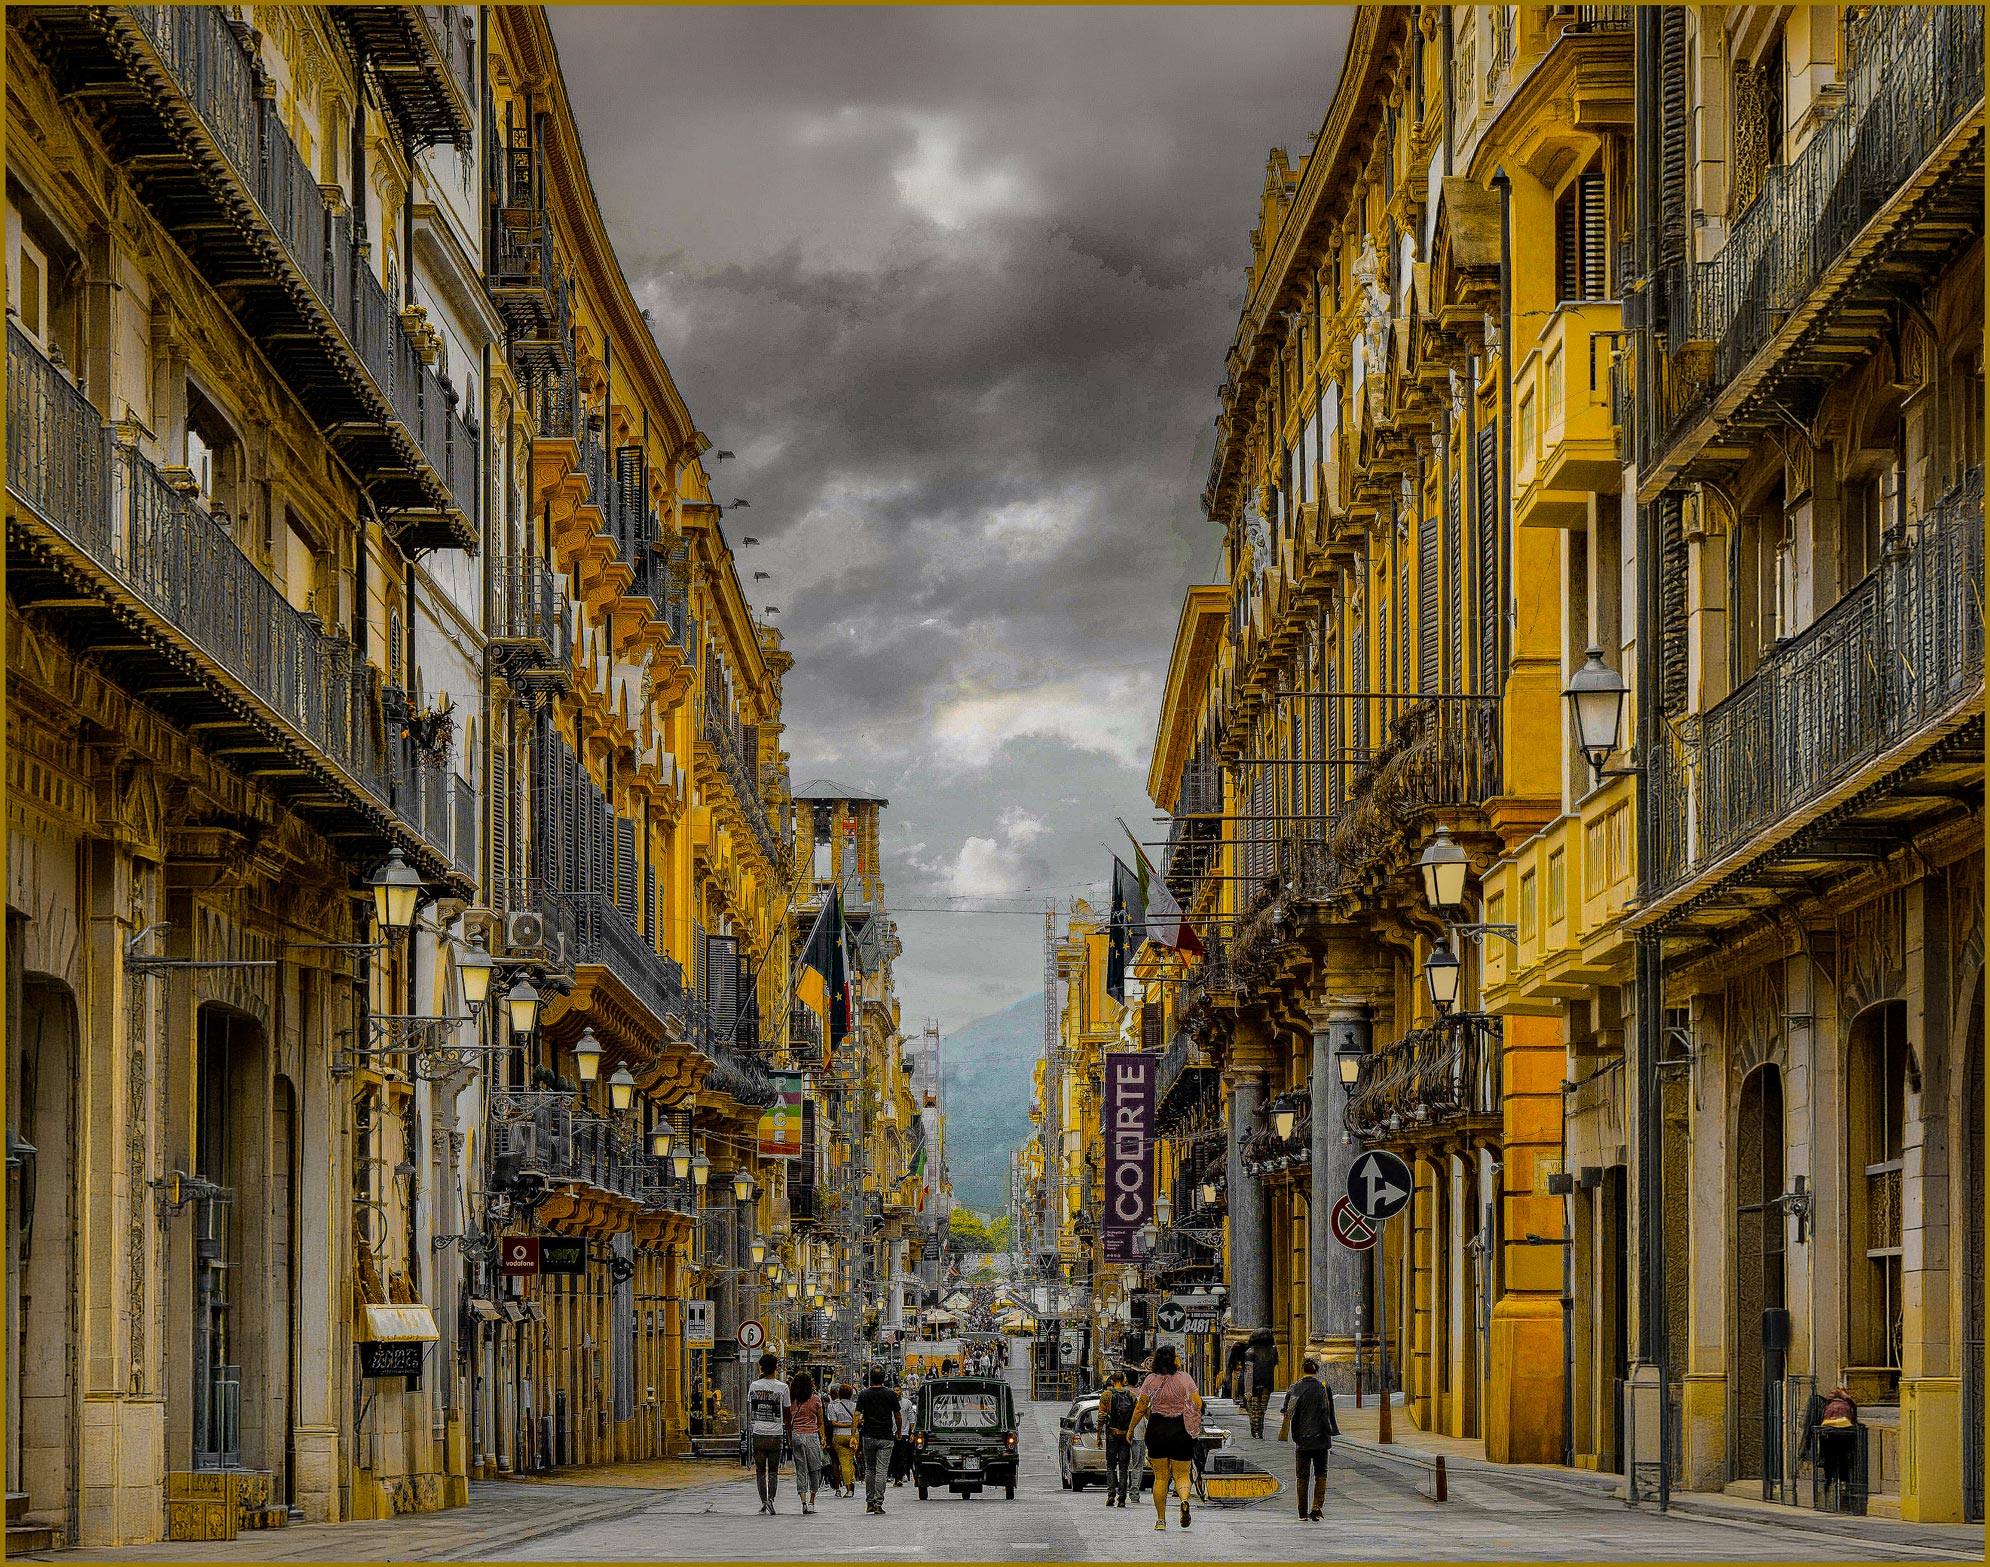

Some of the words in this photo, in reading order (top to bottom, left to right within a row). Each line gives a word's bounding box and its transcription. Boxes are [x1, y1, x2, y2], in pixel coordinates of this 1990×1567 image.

[773, 1076, 787, 1144] PACE
[1183, 1318, 1210, 1333] 8481
[748, 1327, 755, 1342] 6
